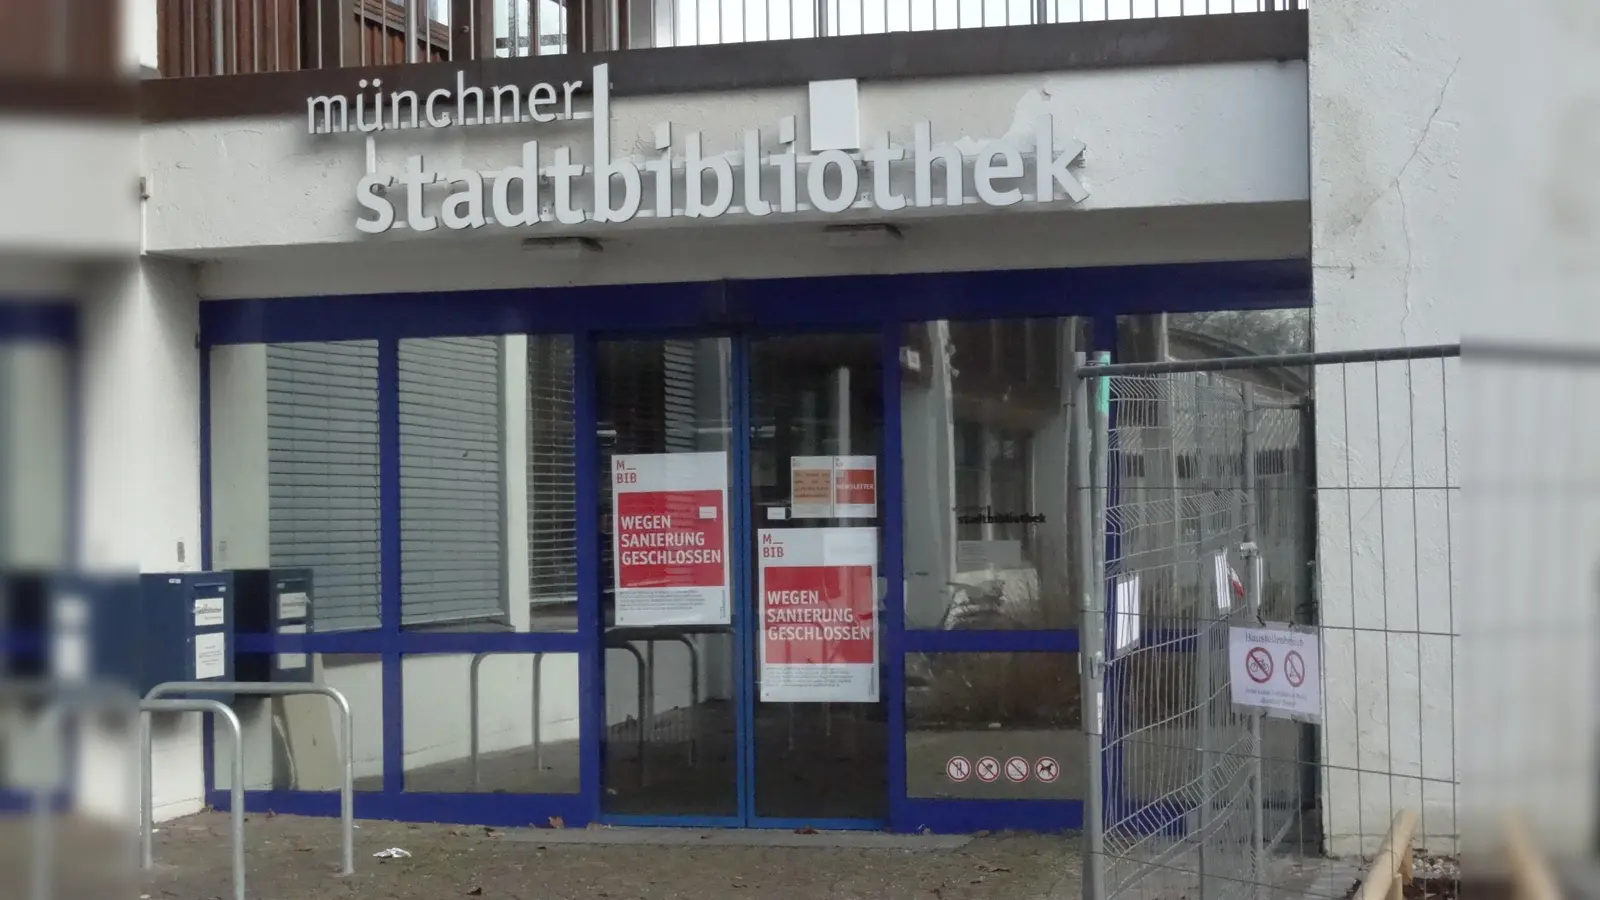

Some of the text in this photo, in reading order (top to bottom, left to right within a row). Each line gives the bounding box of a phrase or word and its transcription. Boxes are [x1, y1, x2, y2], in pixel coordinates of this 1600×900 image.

[306, 70, 582, 134] münchner
[355, 63, 1090, 233] stadtbibliothek
[616, 473, 637, 484] BIB
[621, 515, 671, 530] WEGEN
[621, 532, 705, 548] SANIERUNG
[622, 549, 721, 566] GESCHLOSSEN
[762, 546, 784, 558] BIB
[767, 590, 819, 605] WEGEN
[767, 607, 854, 623] SANIERUNG
[768, 625, 871, 641] GESCHLOSSEN
